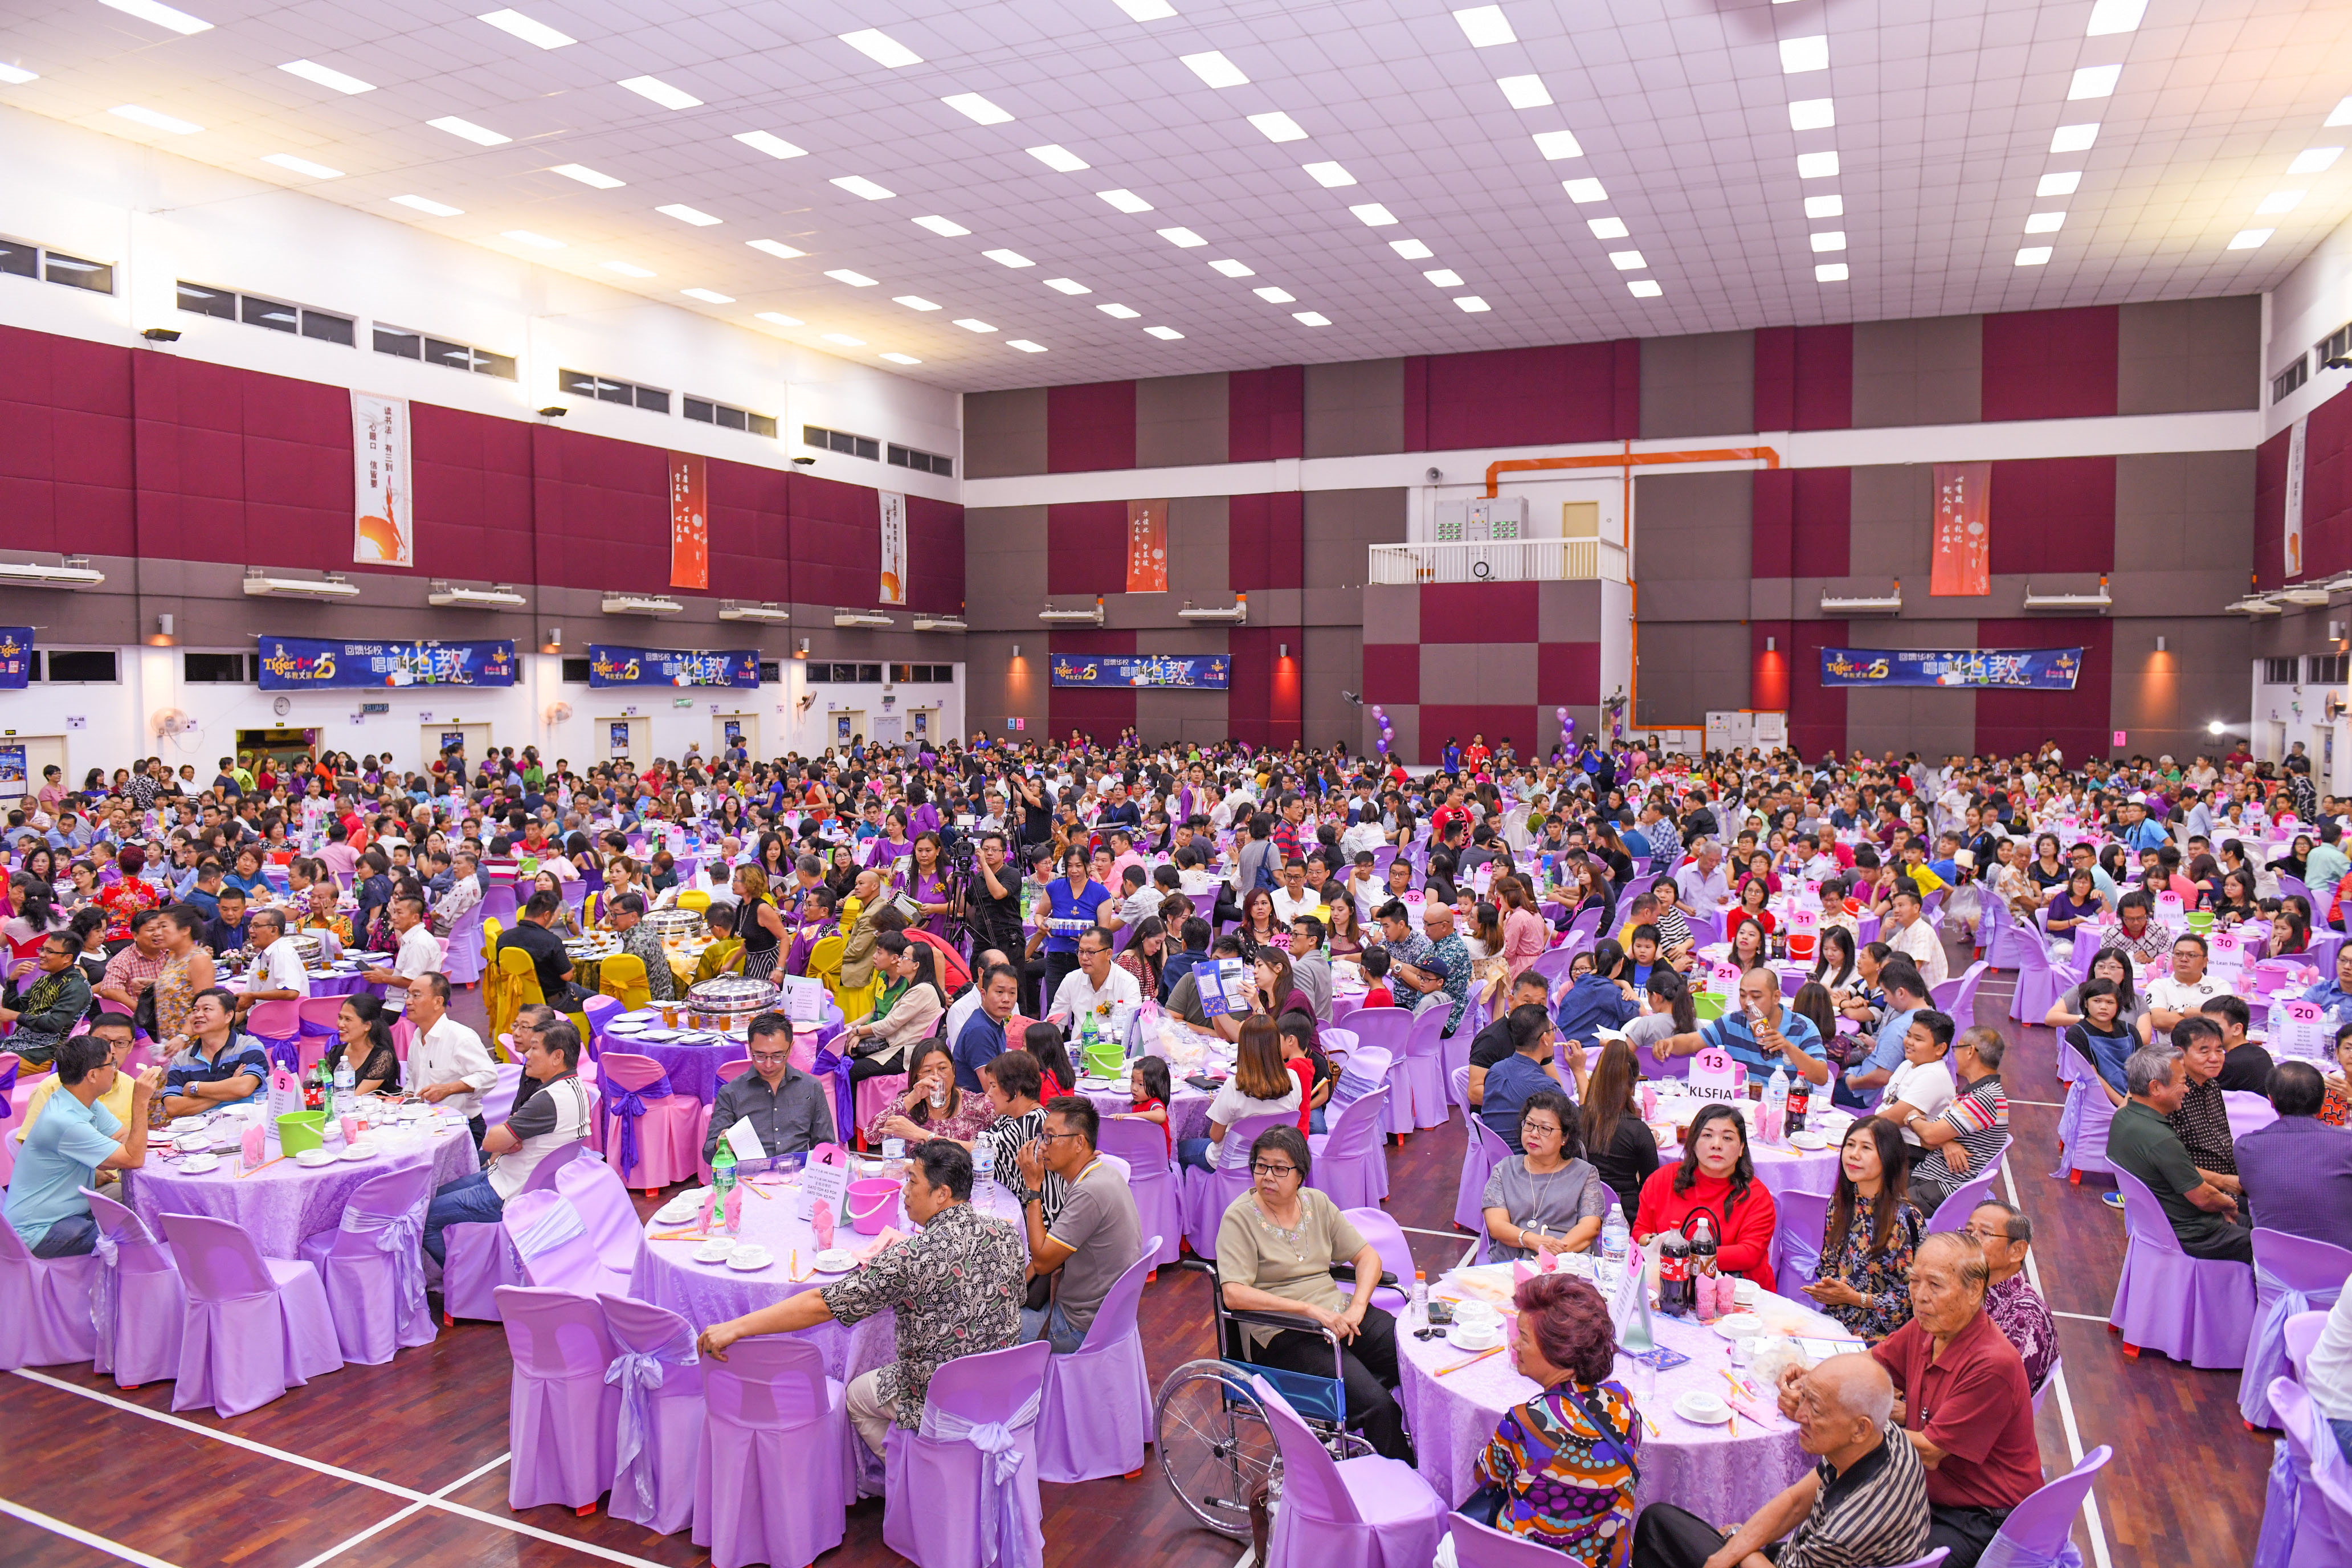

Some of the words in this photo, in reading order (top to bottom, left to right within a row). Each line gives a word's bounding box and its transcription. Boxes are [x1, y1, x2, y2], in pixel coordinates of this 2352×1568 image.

[384, 406, 393, 434] 读书法
[385, 444, 393, 472] 有三到
[345, 644, 382, 655] 回馈华校
[263, 657, 296, 675] Tiger
[593, 662, 613, 676] Tiger
[1054, 667, 1072, 677] Tiger
[1827, 662, 1853, 675] Tiger
[2216, 938, 2232, 948] 30
[1718, 969, 1732, 978] 21
[2294, 1008, 2313, 1019] 20
[1704, 1055, 1723, 1068] 13
[279, 1077, 285, 1089] 5
[1689, 1086, 1733, 1100] KLSFIA
[822, 1153, 832, 1165] 4
[1632, 1250, 1638, 1267] 3
